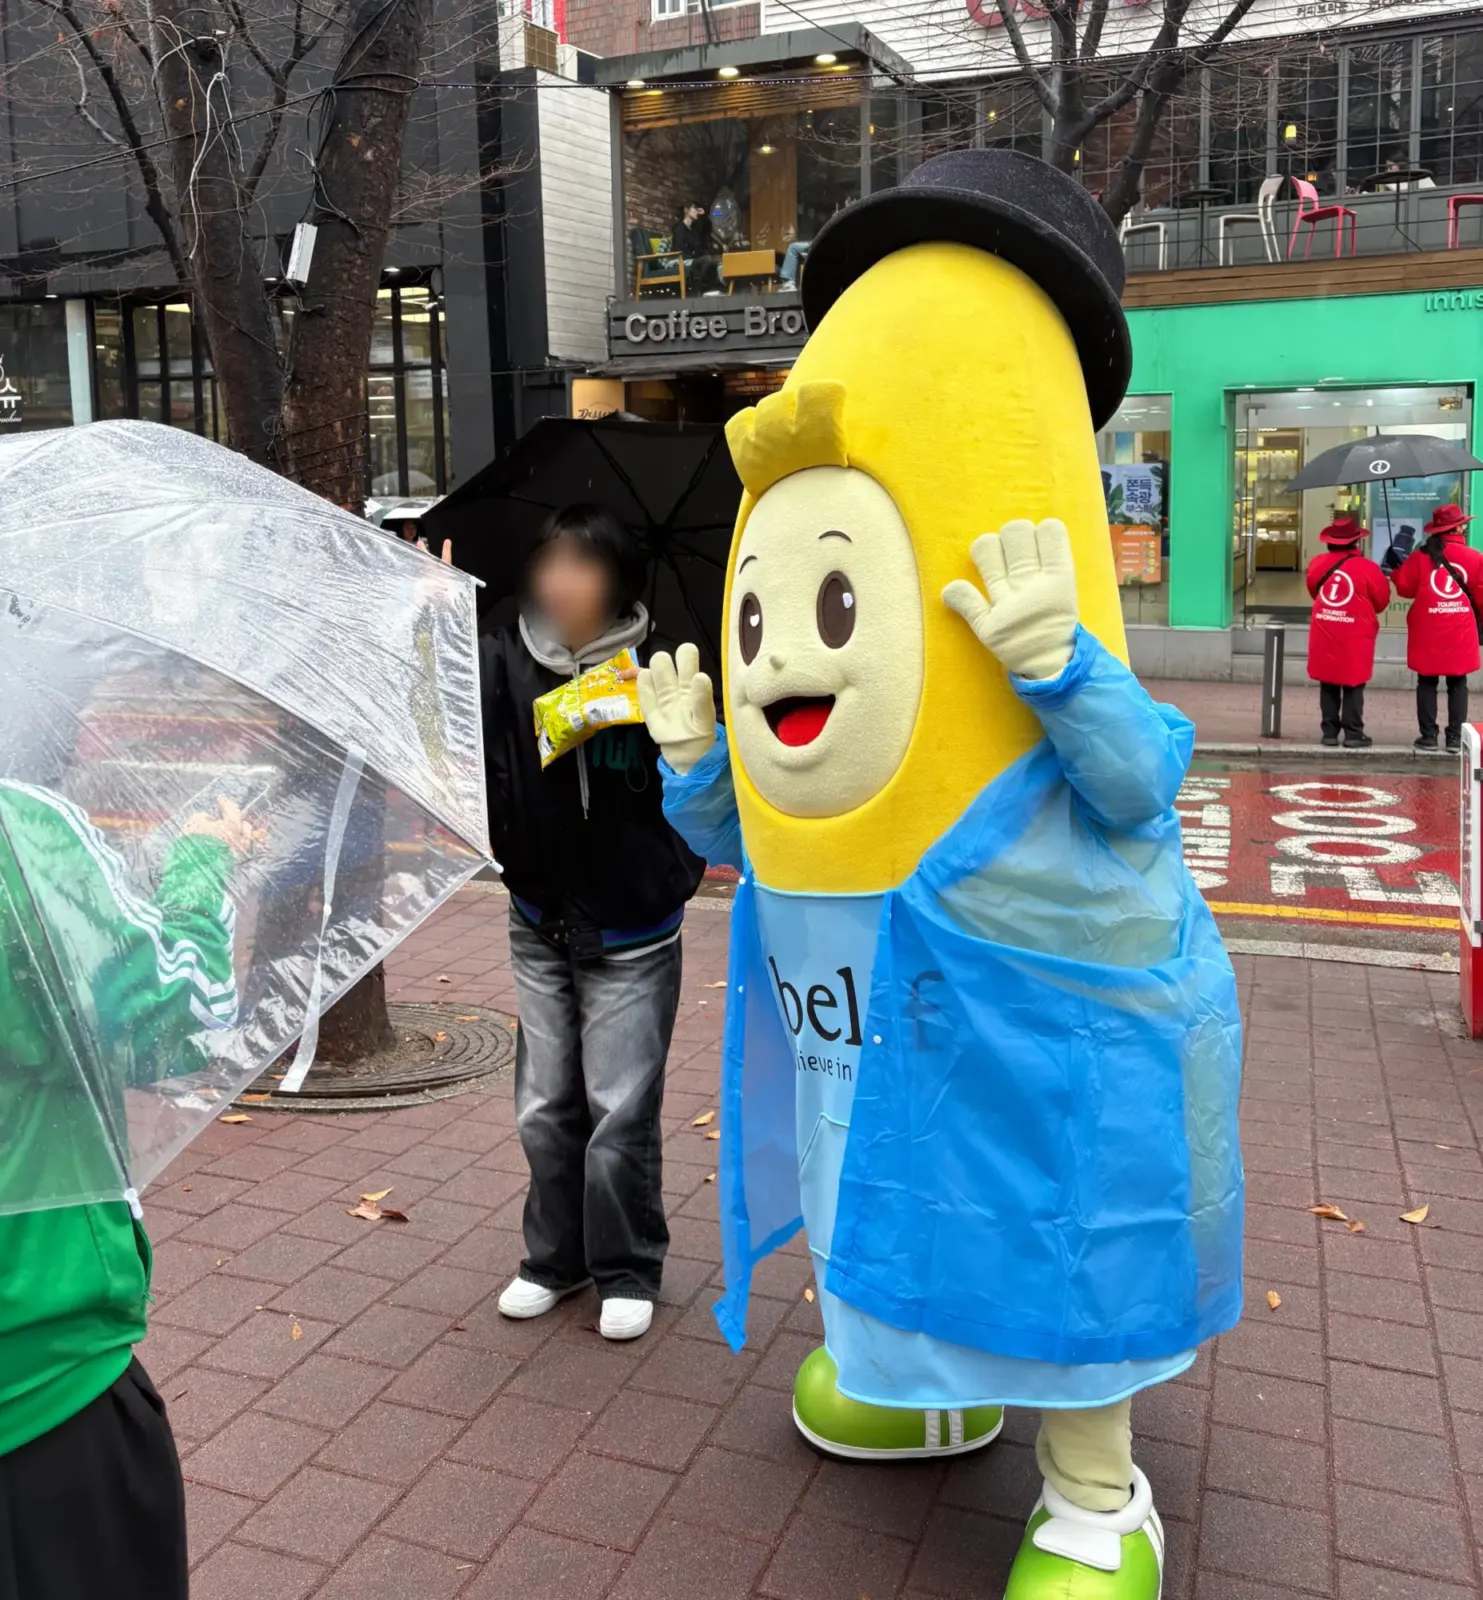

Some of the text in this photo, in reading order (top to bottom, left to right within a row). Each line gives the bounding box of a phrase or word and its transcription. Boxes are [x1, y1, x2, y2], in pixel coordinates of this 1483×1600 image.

[624, 309, 728, 343] Coffee
[1322, 608, 1347, 617] TOURIST
[1428, 606, 1470, 614] INFORMATION
[1315, 613, 1355, 623] INFORMATION
[836, 1056, 852, 1082] in
